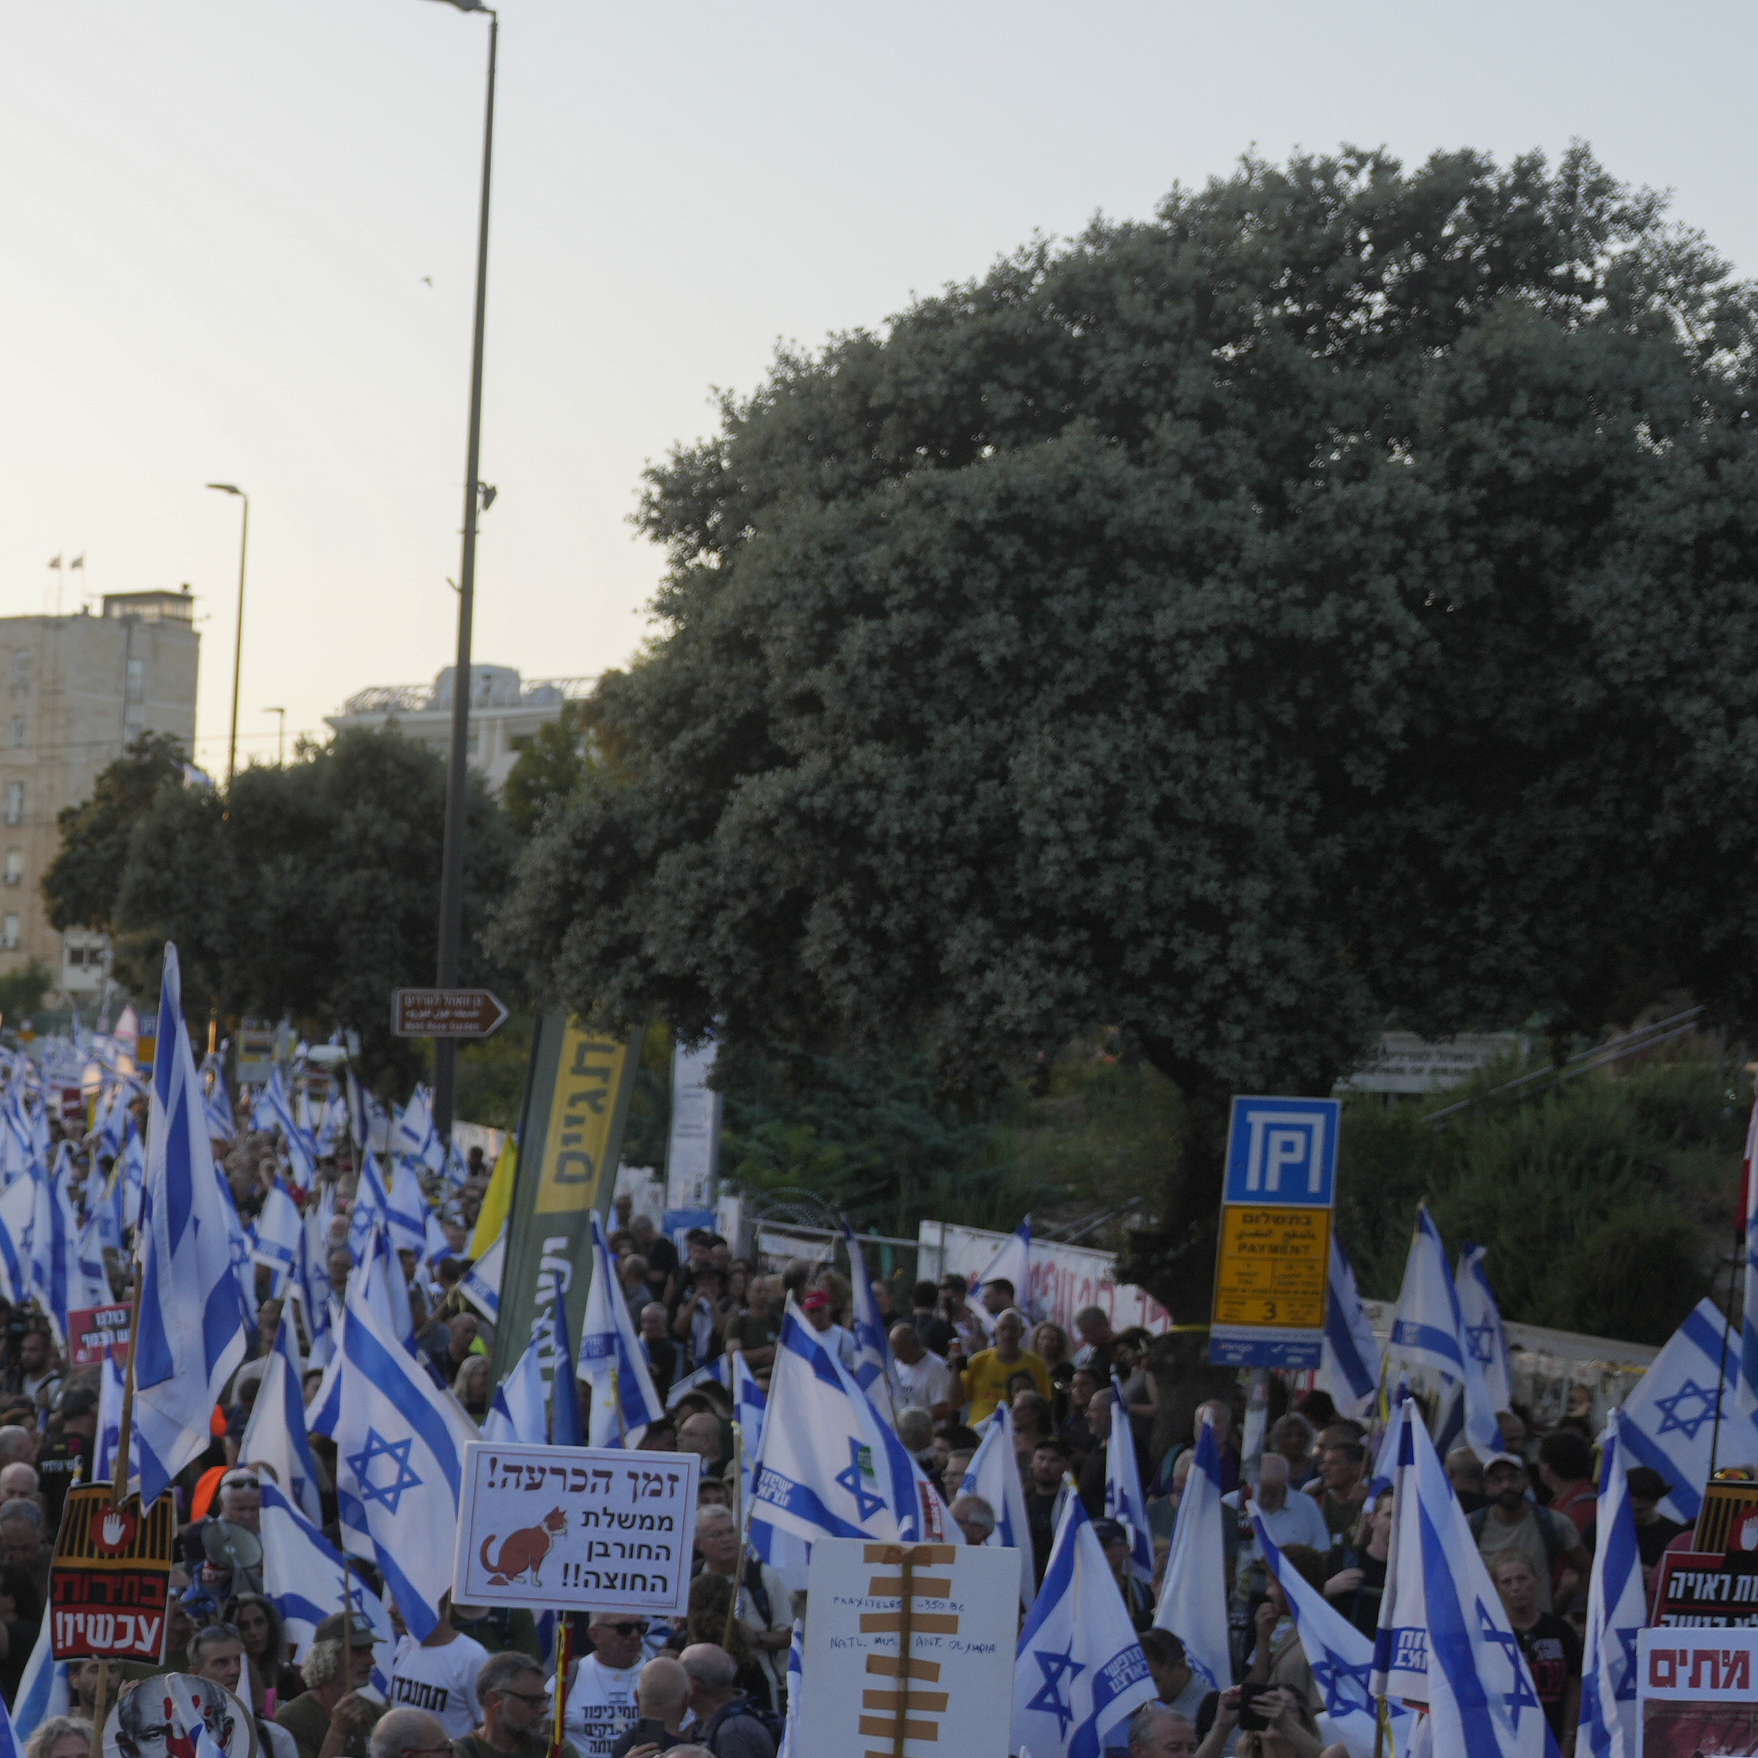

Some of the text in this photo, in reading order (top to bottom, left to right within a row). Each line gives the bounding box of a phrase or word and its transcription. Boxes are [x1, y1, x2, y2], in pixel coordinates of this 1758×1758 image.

[1237, 1243, 1311, 1258] PAYMENT
[488, 1461, 679, 1501] זמן הכרעה!
[582, 1509, 674, 1532] ממשלת
[587, 1539, 672, 1563] החורבן
[54, 1574, 164, 1604] בחירות
[561, 1564, 669, 1593] החוצה!!
[1667, 1571, 1729, 1600] ראויה
[56, 1612, 160, 1651] עכשיו!
